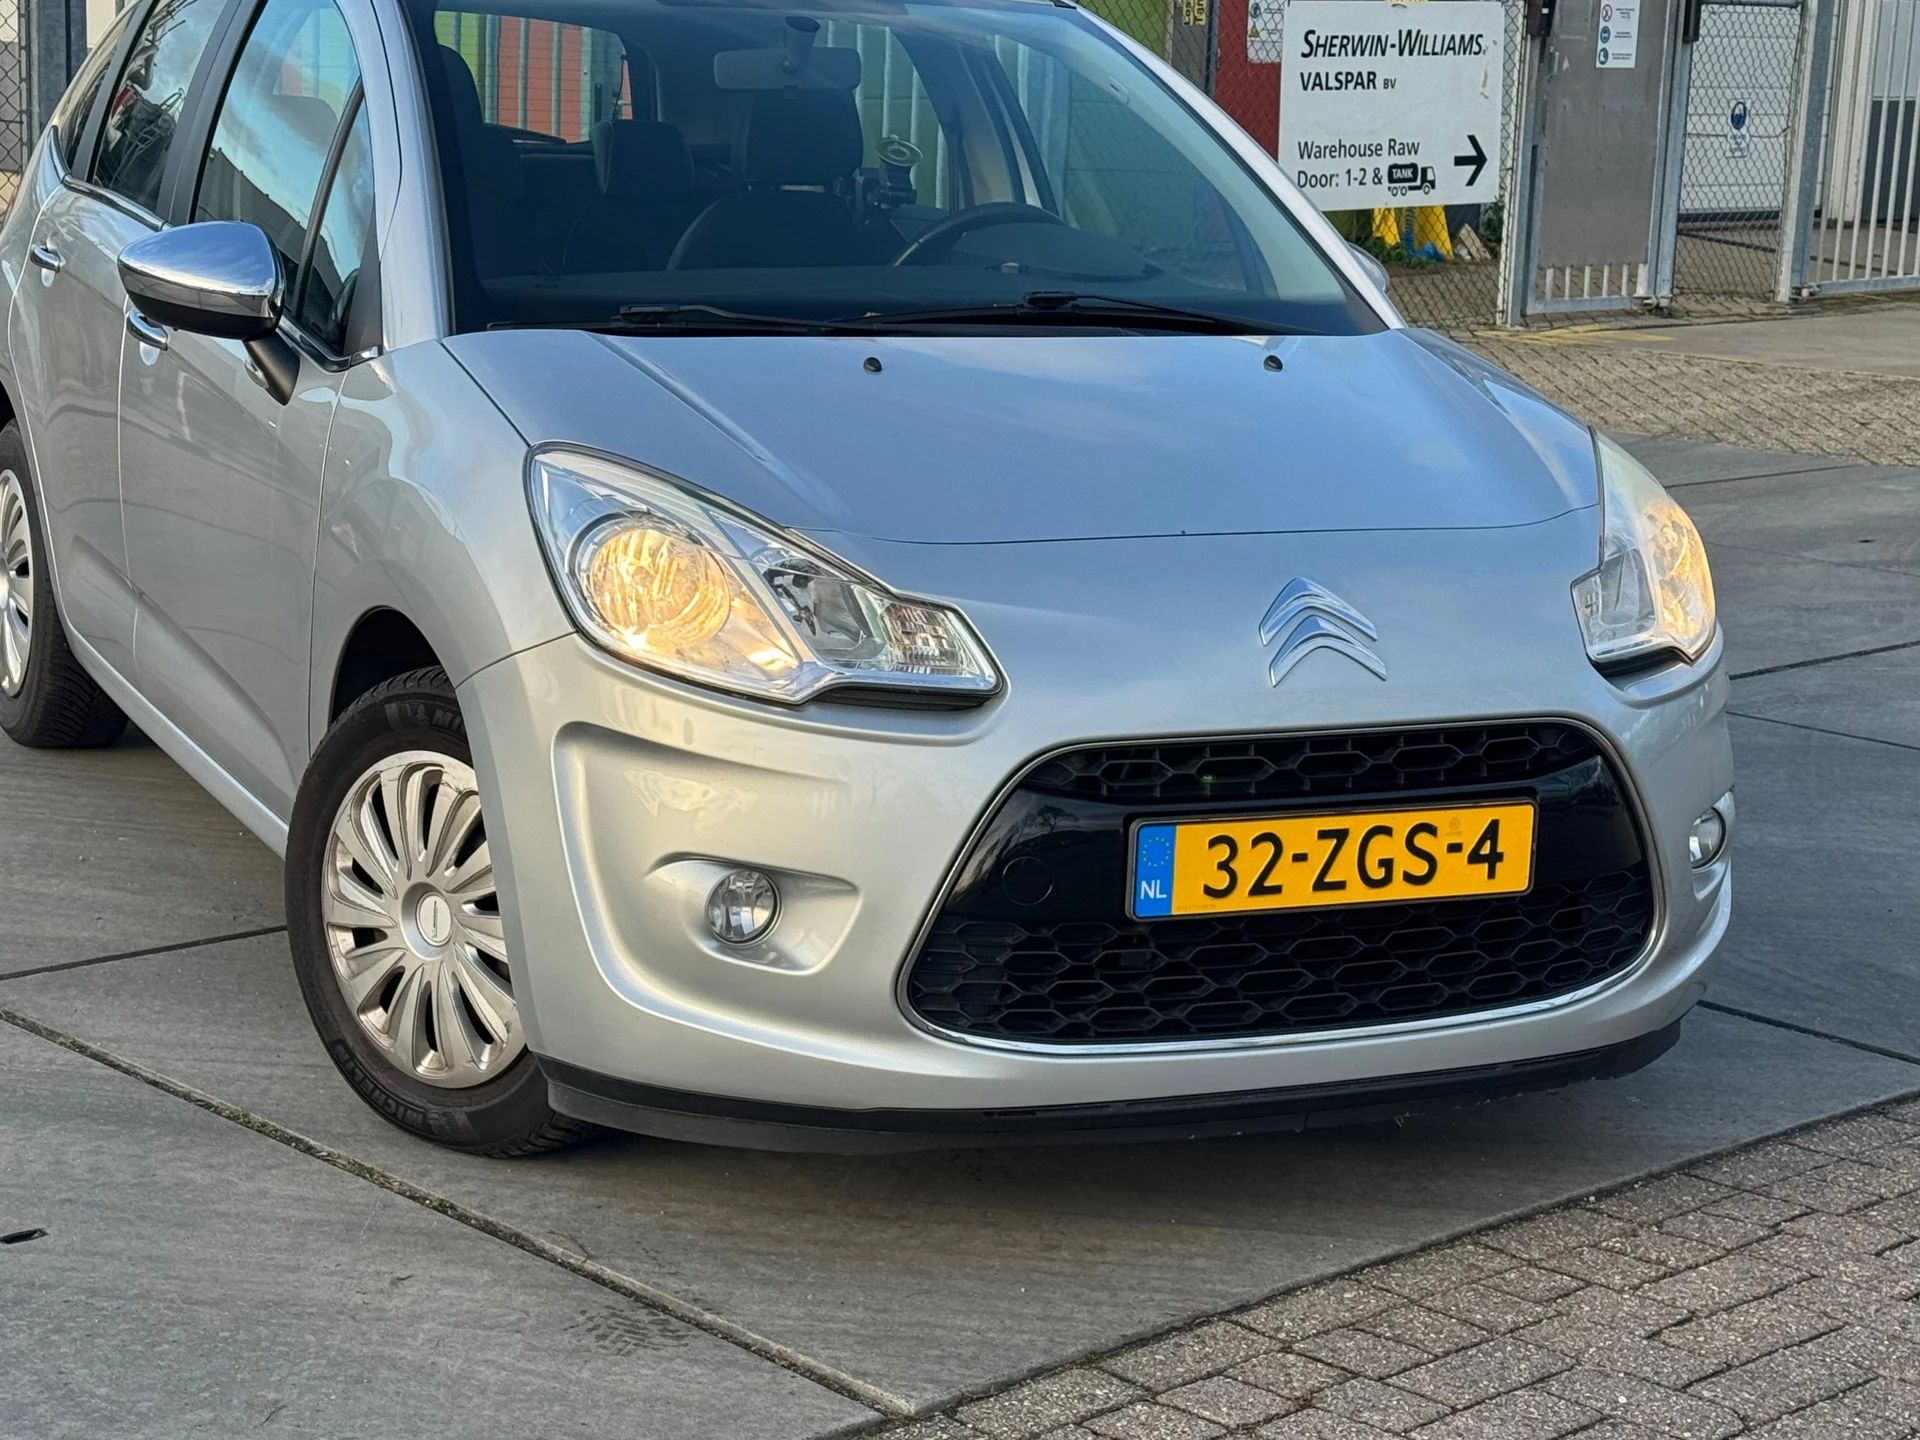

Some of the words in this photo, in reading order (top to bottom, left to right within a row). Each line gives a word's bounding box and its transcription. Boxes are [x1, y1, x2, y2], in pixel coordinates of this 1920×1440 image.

[1300, 71, 1377, 91] VALSPAR
[1383, 78, 1397, 90] BV
[1298, 139, 1383, 160] Warehouse
[1388, 139, 1420, 156] Raw
[1297, 170, 1339, 189] Door:
[1345, 168, 1367, 187] 1-2
[1372, 167, 1383, 185] &
[1392, 168, 1413, 179] TANK
[1202, 818, 1504, 898] 32-ZGS-4
[1140, 881, 1167, 900] NL
